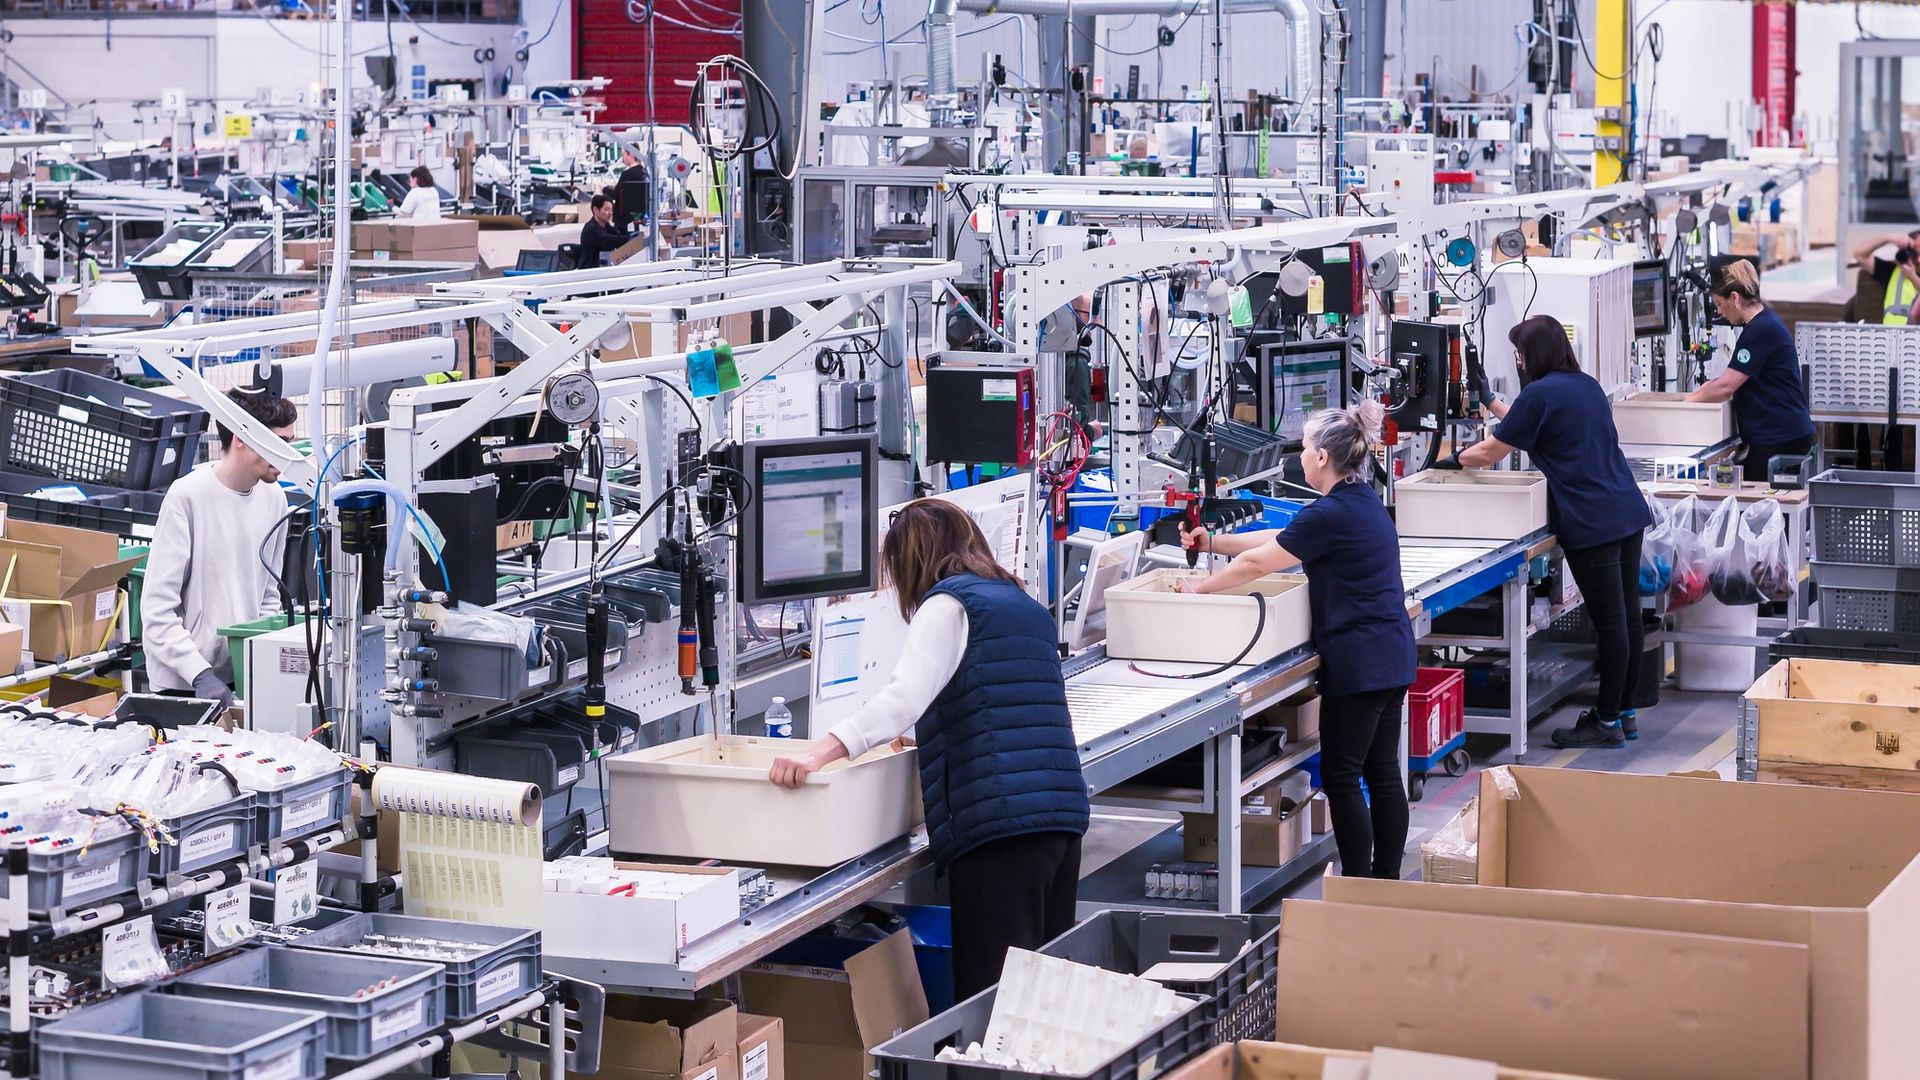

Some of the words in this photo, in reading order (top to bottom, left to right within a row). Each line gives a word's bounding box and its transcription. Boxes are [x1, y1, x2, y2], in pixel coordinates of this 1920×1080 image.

[511, 523, 519, 539] A
[189, 836, 210, 847] 4080615
[217, 898, 239, 910] 4080614
